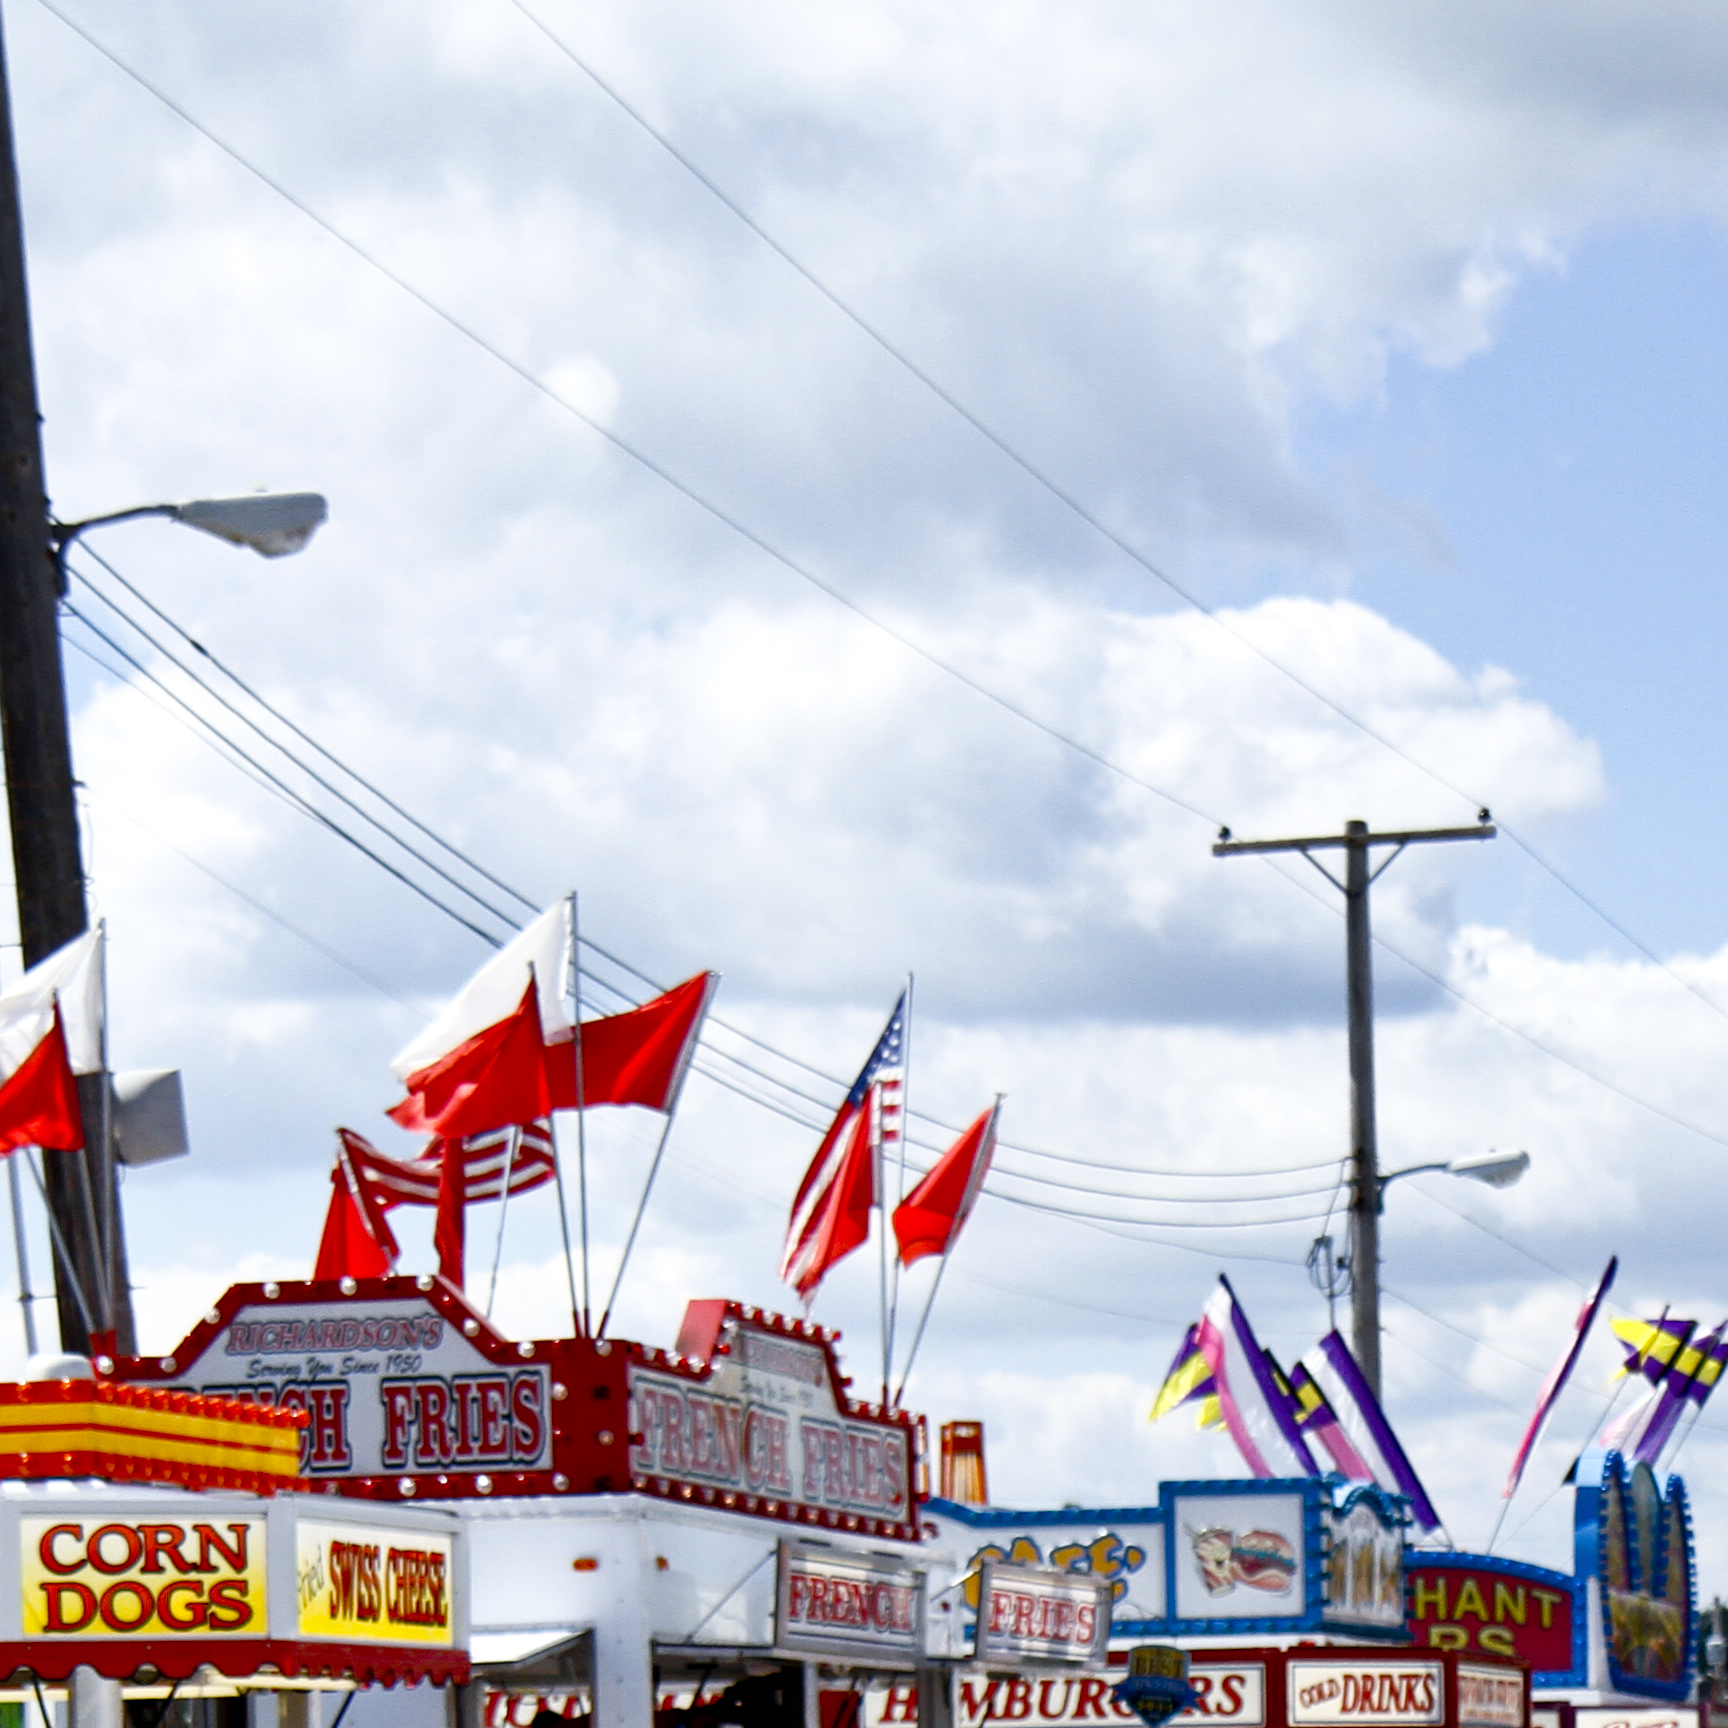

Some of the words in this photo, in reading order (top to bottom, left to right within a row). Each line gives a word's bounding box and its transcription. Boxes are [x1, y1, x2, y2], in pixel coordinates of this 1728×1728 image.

[225, 1312, 444, 1355] RICHARDSON'S
[246, 1358, 301, 1381] Serving
[306, 1356, 333, 1381] You
[339, 1357, 380, 1375] Since
[380, 1371, 546, 1468] FRIES
[633, 1376, 791, 1496] FRENCH
[800, 1415, 906, 1511] FRIES
[39, 1522, 250, 1576] CORN
[42, 1578, 252, 1634] DOGS
[330, 1540, 381, 1622] SWISS
[387, 1547, 447, 1627] CHEESE
[789, 1572, 916, 1634] FRENCH
[988, 1588, 1097, 1646] FRIES
[878, 1673, 1248, 1724] HMBURRS
[1300, 1678, 1340, 1708] COLD
[1340, 1673, 1436, 1714] DRINKS
